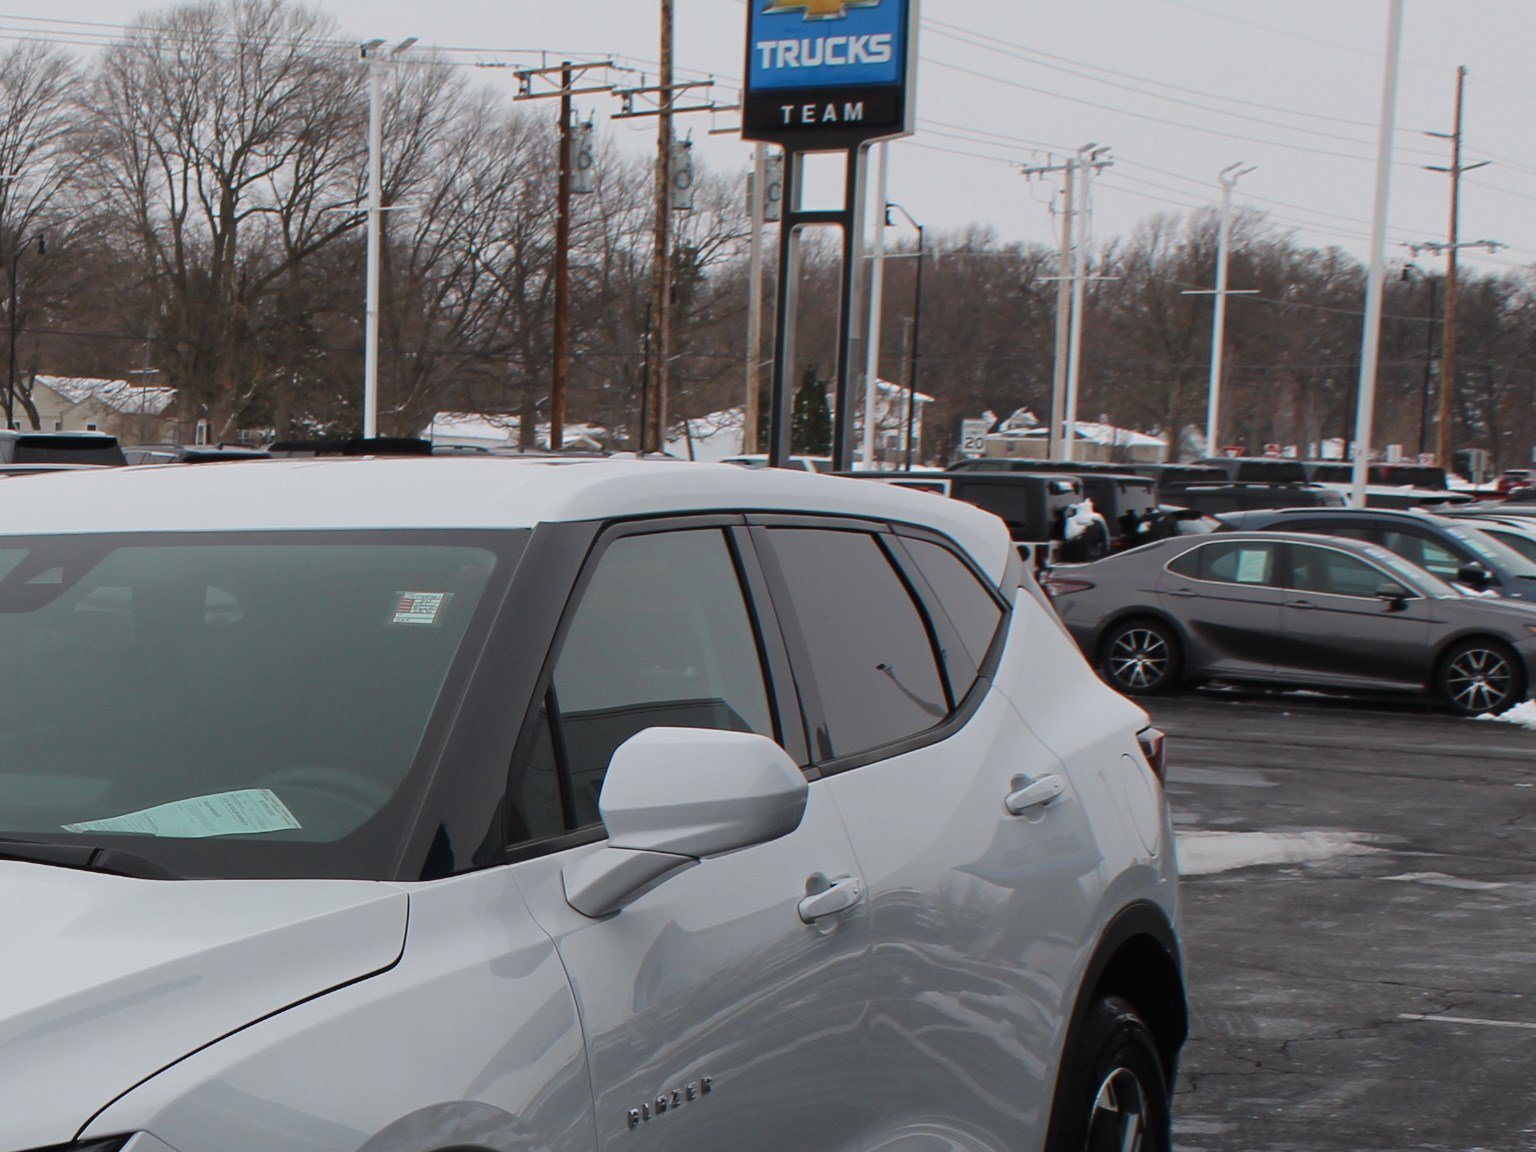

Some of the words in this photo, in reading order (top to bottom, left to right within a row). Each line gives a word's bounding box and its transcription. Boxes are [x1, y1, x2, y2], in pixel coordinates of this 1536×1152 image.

[756, 33, 892, 69] TRUCKS
[781, 102, 864, 124] TEAM
[965, 436, 984, 449] 20
[628, 1076, 712, 1130] BLAZER
